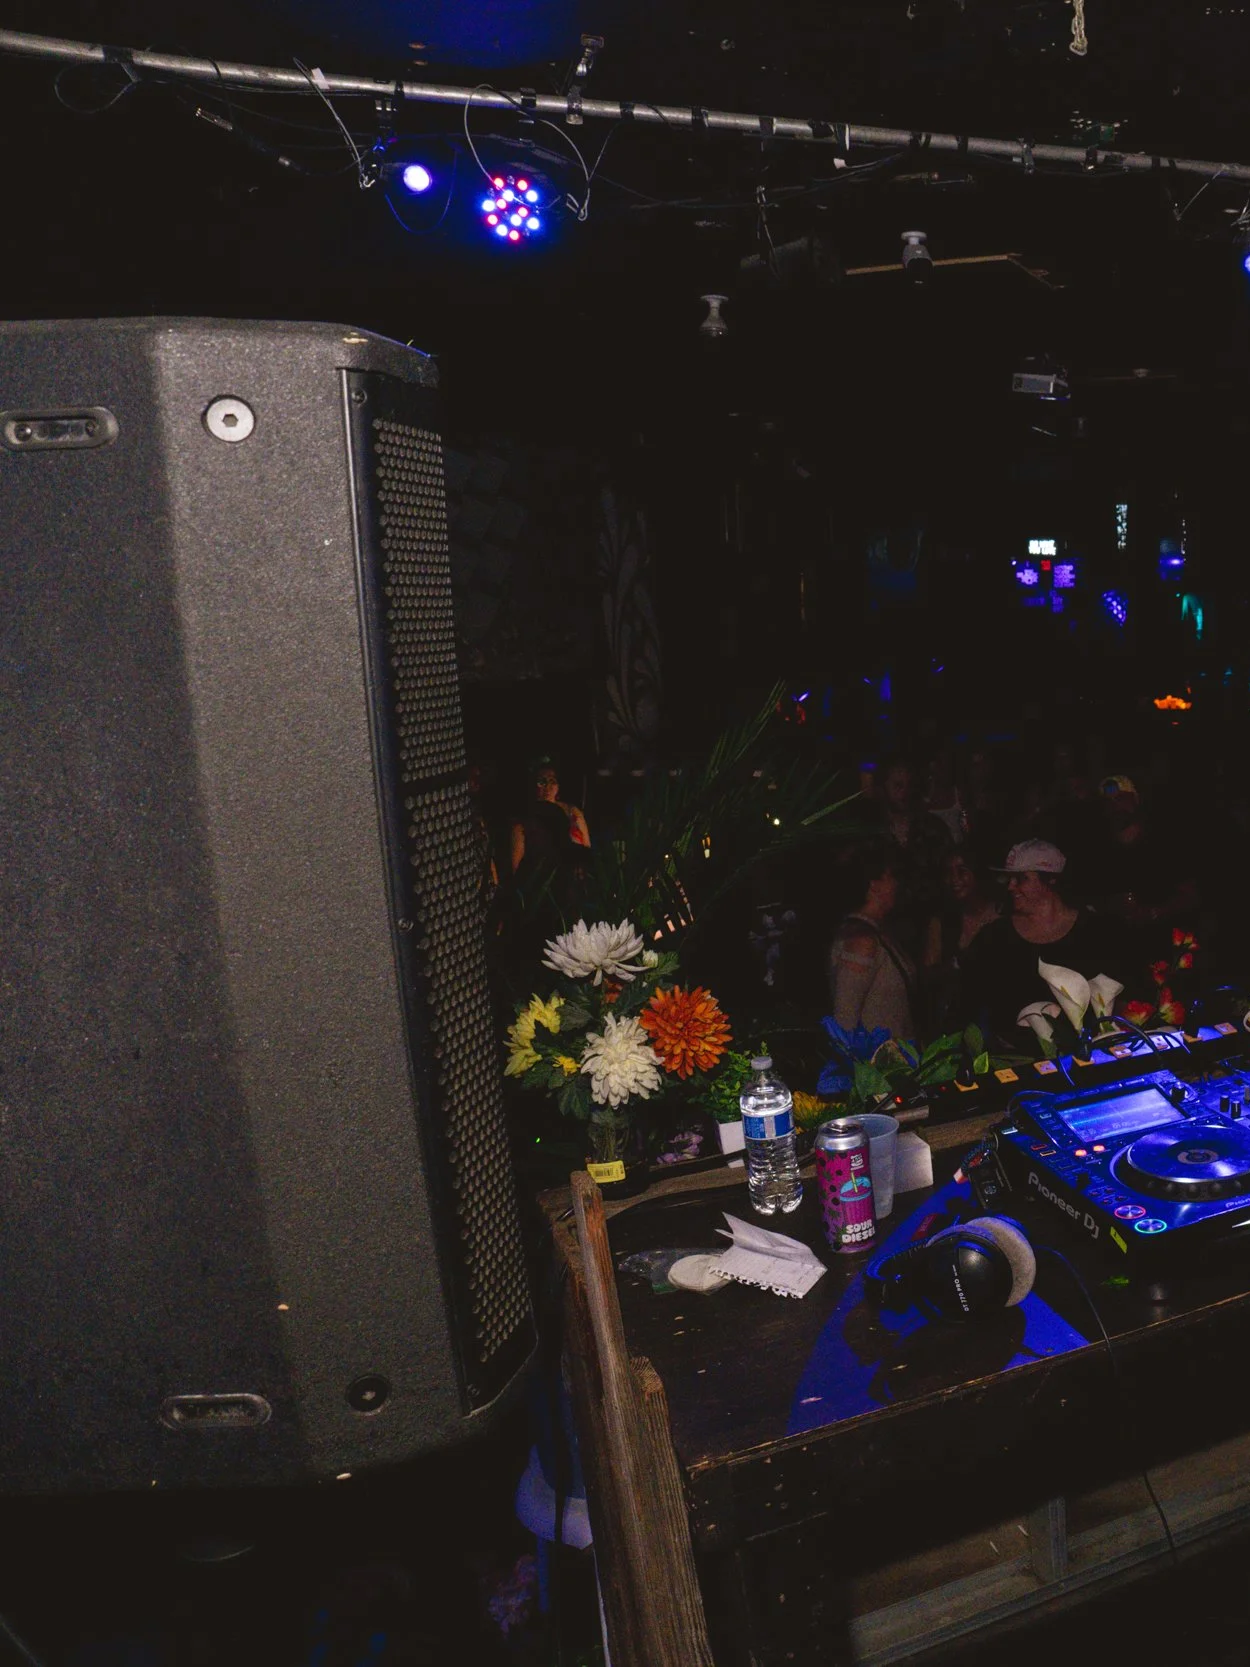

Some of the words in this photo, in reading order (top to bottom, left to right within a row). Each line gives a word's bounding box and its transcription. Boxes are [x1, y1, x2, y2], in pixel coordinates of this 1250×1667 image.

[1028, 1171, 1081, 1220] Pioneer
[845, 1218, 873, 1234] SOUR
[841, 1226, 876, 1244] DIESEL
[954, 1278, 963, 1292] PRO
